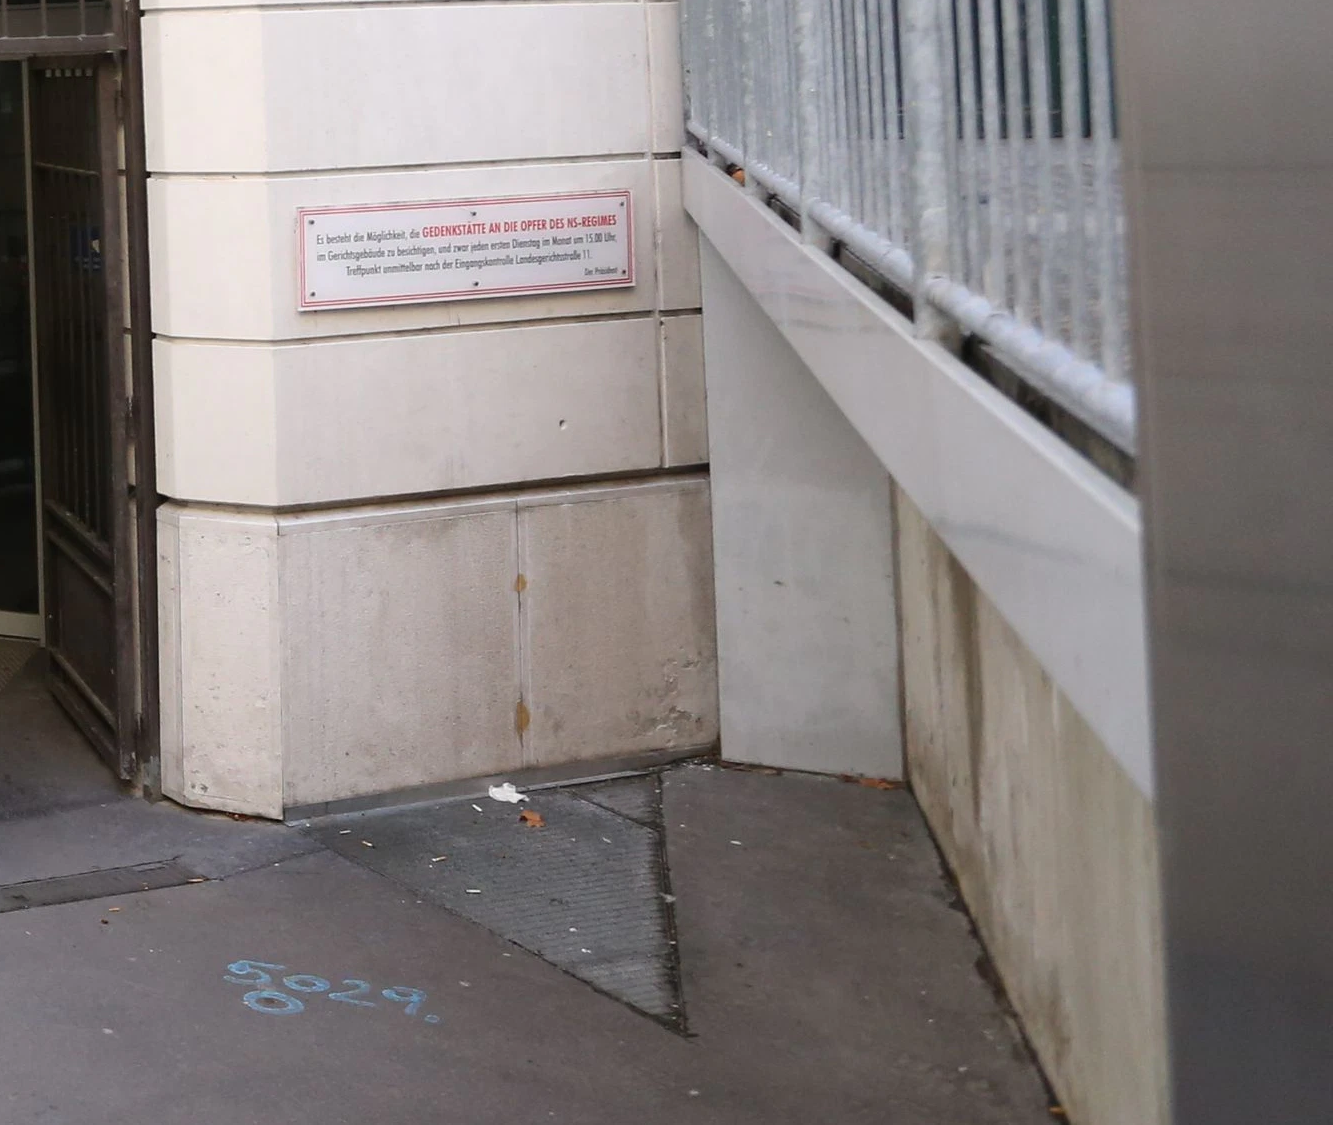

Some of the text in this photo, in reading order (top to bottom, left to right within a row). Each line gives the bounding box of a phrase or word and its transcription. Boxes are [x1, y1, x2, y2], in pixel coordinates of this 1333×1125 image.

[316, 234, 324, 244] Es
[326, 232, 351, 244] besteht
[353, 231, 364, 242] die
[409, 228, 420, 239] die
[422, 220, 486, 238] GEDENKSTÄTTE
[489, 222, 501, 233] AN
[504, 221, 518, 232] DIE
[520, 219, 547, 231] OPFER
[549, 218, 564, 229] DES
[567, 214, 617, 228] NS-REGIMES
[316, 252, 326, 261] im
[328, 247, 385, 261] Gerichtsgebäude
[387, 249, 395, 257] zu
[438, 242, 451, 254] und
[453, 244, 469, 253] zwar
[470, 240, 489, 253] jeden
[491, 241, 510, 250] ersten
[512, 237, 540, 249] Dienstag
[552, 235, 572, 245] Monat
[346, 264, 381, 277] Treffpunkt
[425, 259, 440, 271] nach
[442, 259, 453, 269] der
